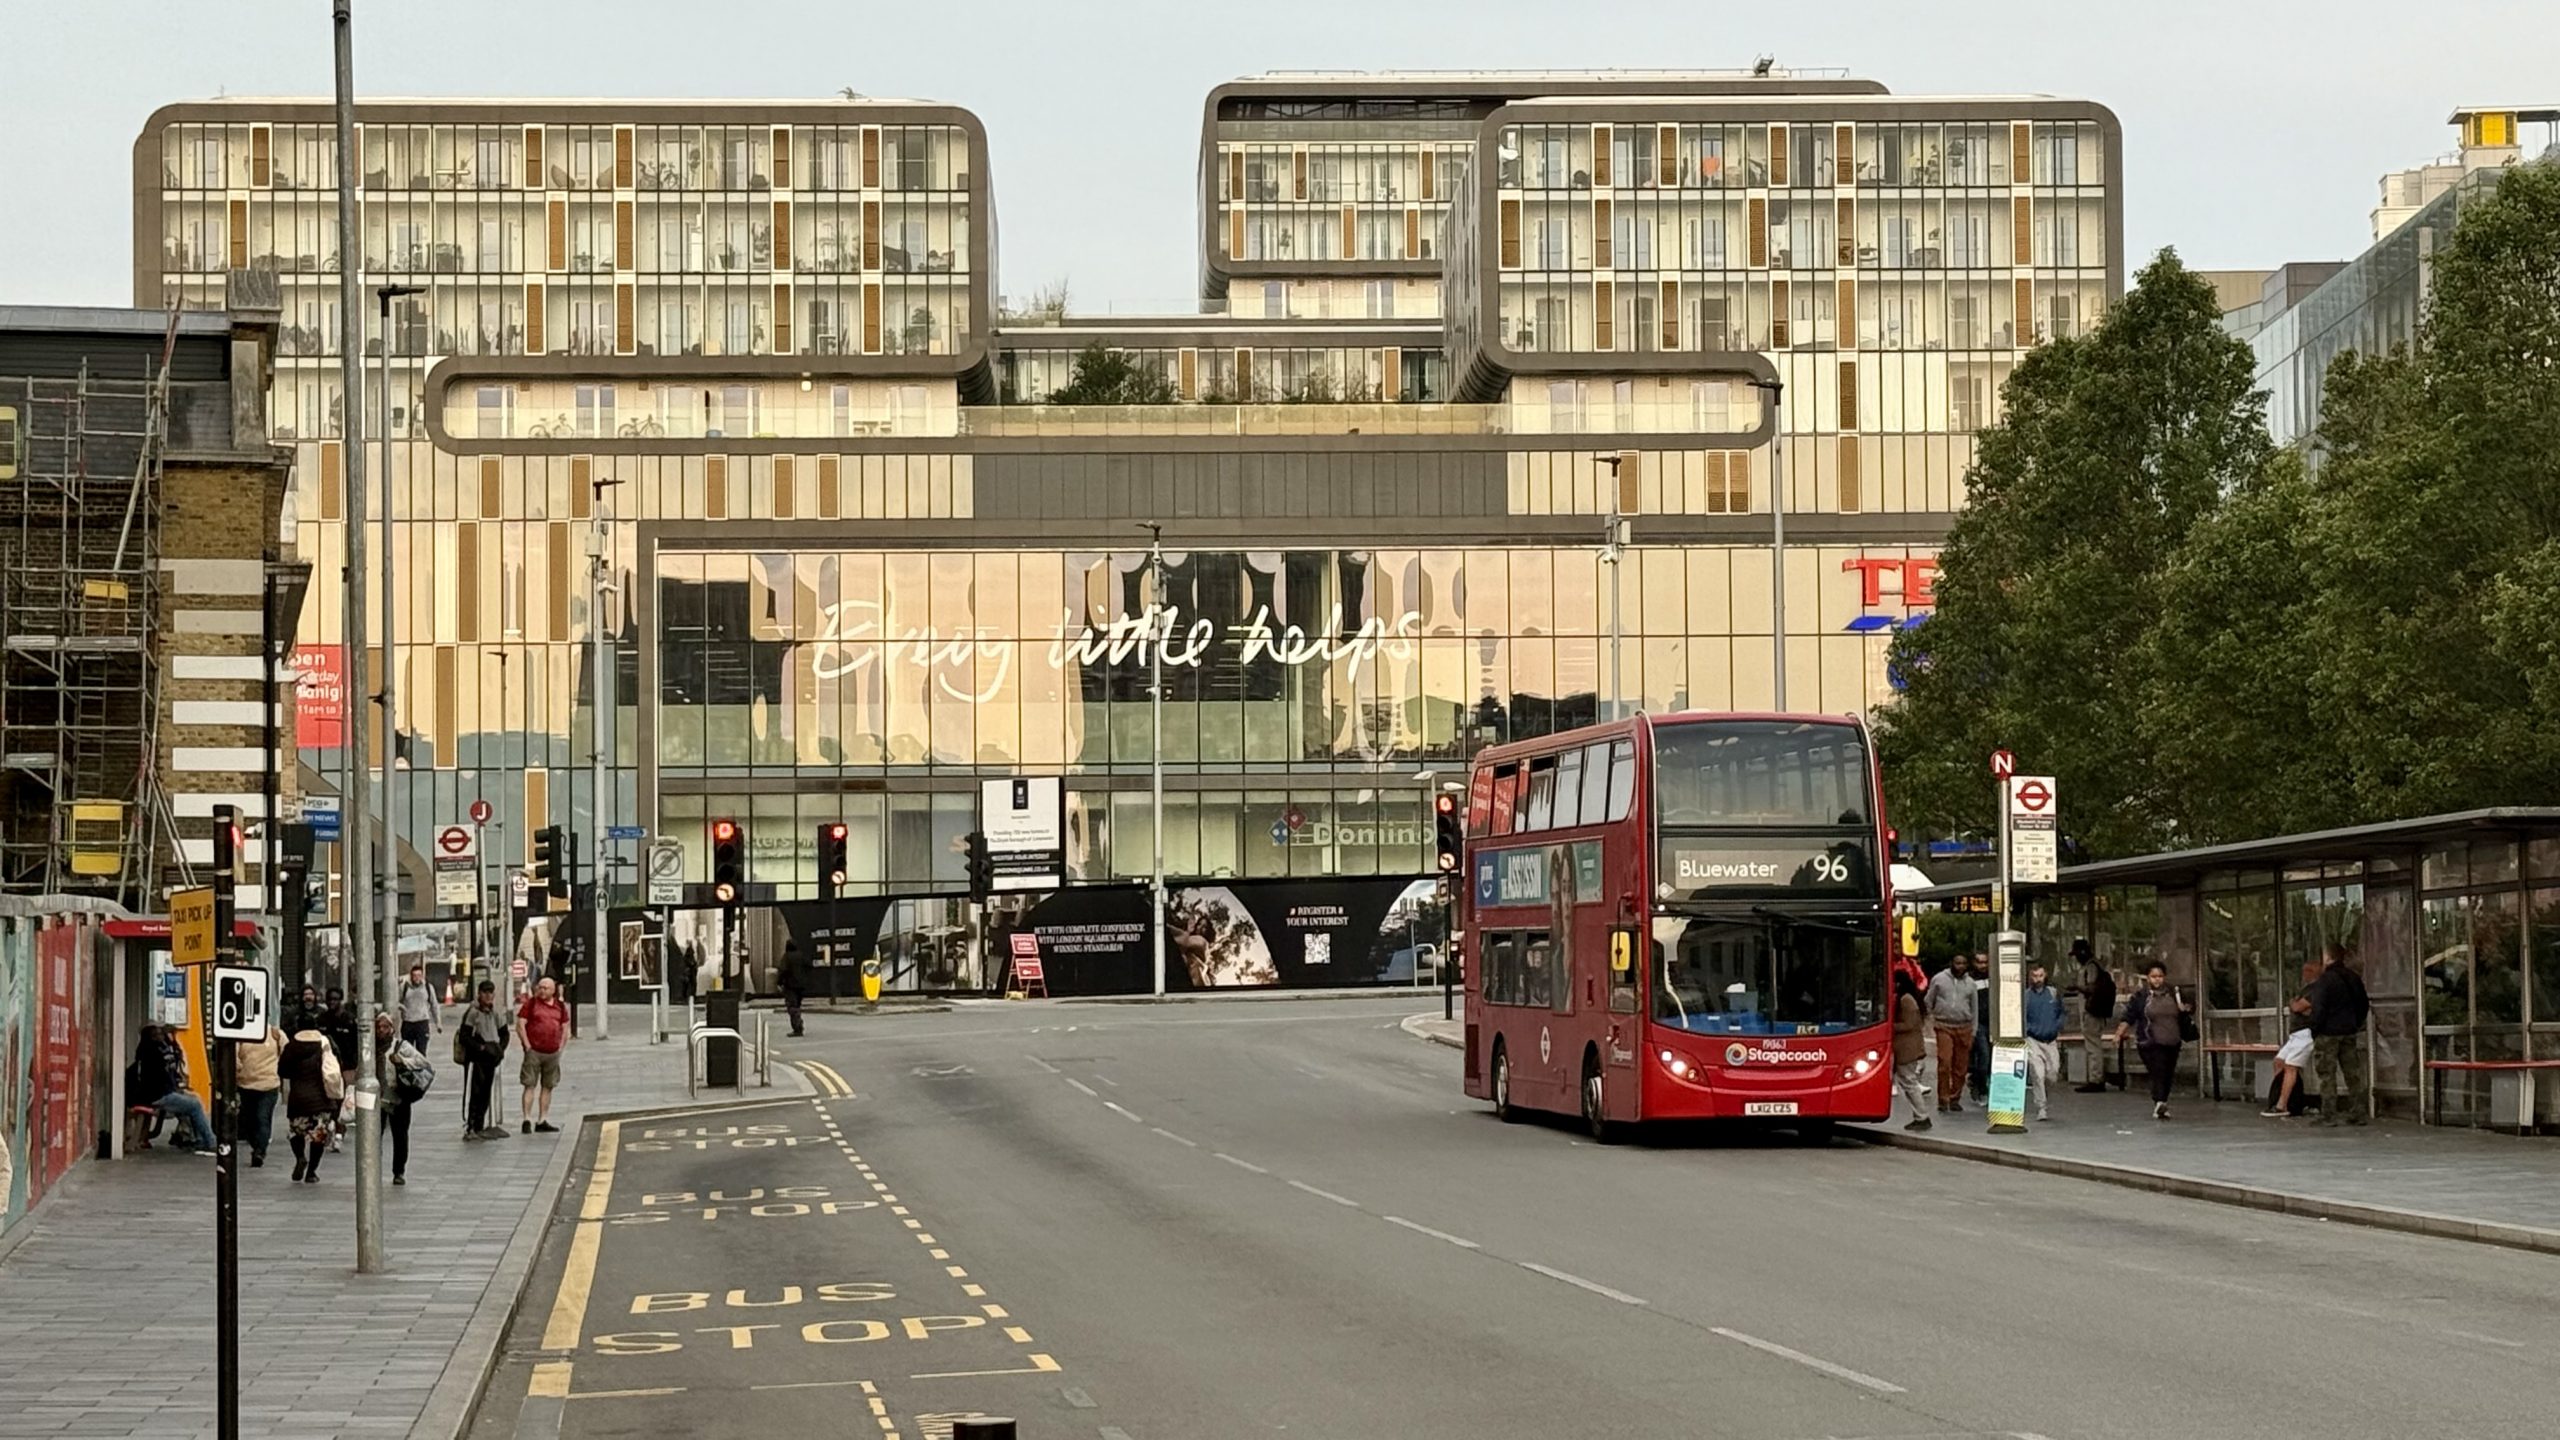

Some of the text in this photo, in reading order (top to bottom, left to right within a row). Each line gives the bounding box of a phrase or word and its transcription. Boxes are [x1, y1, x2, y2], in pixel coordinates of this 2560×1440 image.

[812, 599, 1423, 704] Every little helps
[1994, 753, 2013, 774] N
[476, 803, 487, 820] J
[1313, 821, 1435, 846] Domino
[1679, 859, 1779, 878] Bluewater
[1813, 854, 1849, 882] 96
[654, 894, 677, 902] ENDS
[173, 904, 213, 925] TAXI PICK UP
[1297, 906, 1338, 916] REGISTER
[1065, 924, 1099, 934] COMPLETE
[1100, 923, 1146, 933] CONFIDENCE
[1286, 916, 1349, 927] YOUR INTEREST
[183, 933, 203, 950] POINT
[1056, 934, 1083, 944] LONDON
[1748, 1047, 1828, 1065] Stagecoach
[1750, 1104, 1772, 1114] LX12
[644, 1124, 791, 1139] BUS
[624, 1135, 832, 1151] STOP
[641, 1185, 832, 1206] BUS
[607, 1201, 880, 1225] STOP
[629, 1282, 897, 1315] BUS
[592, 1315, 987, 1356] STOP
